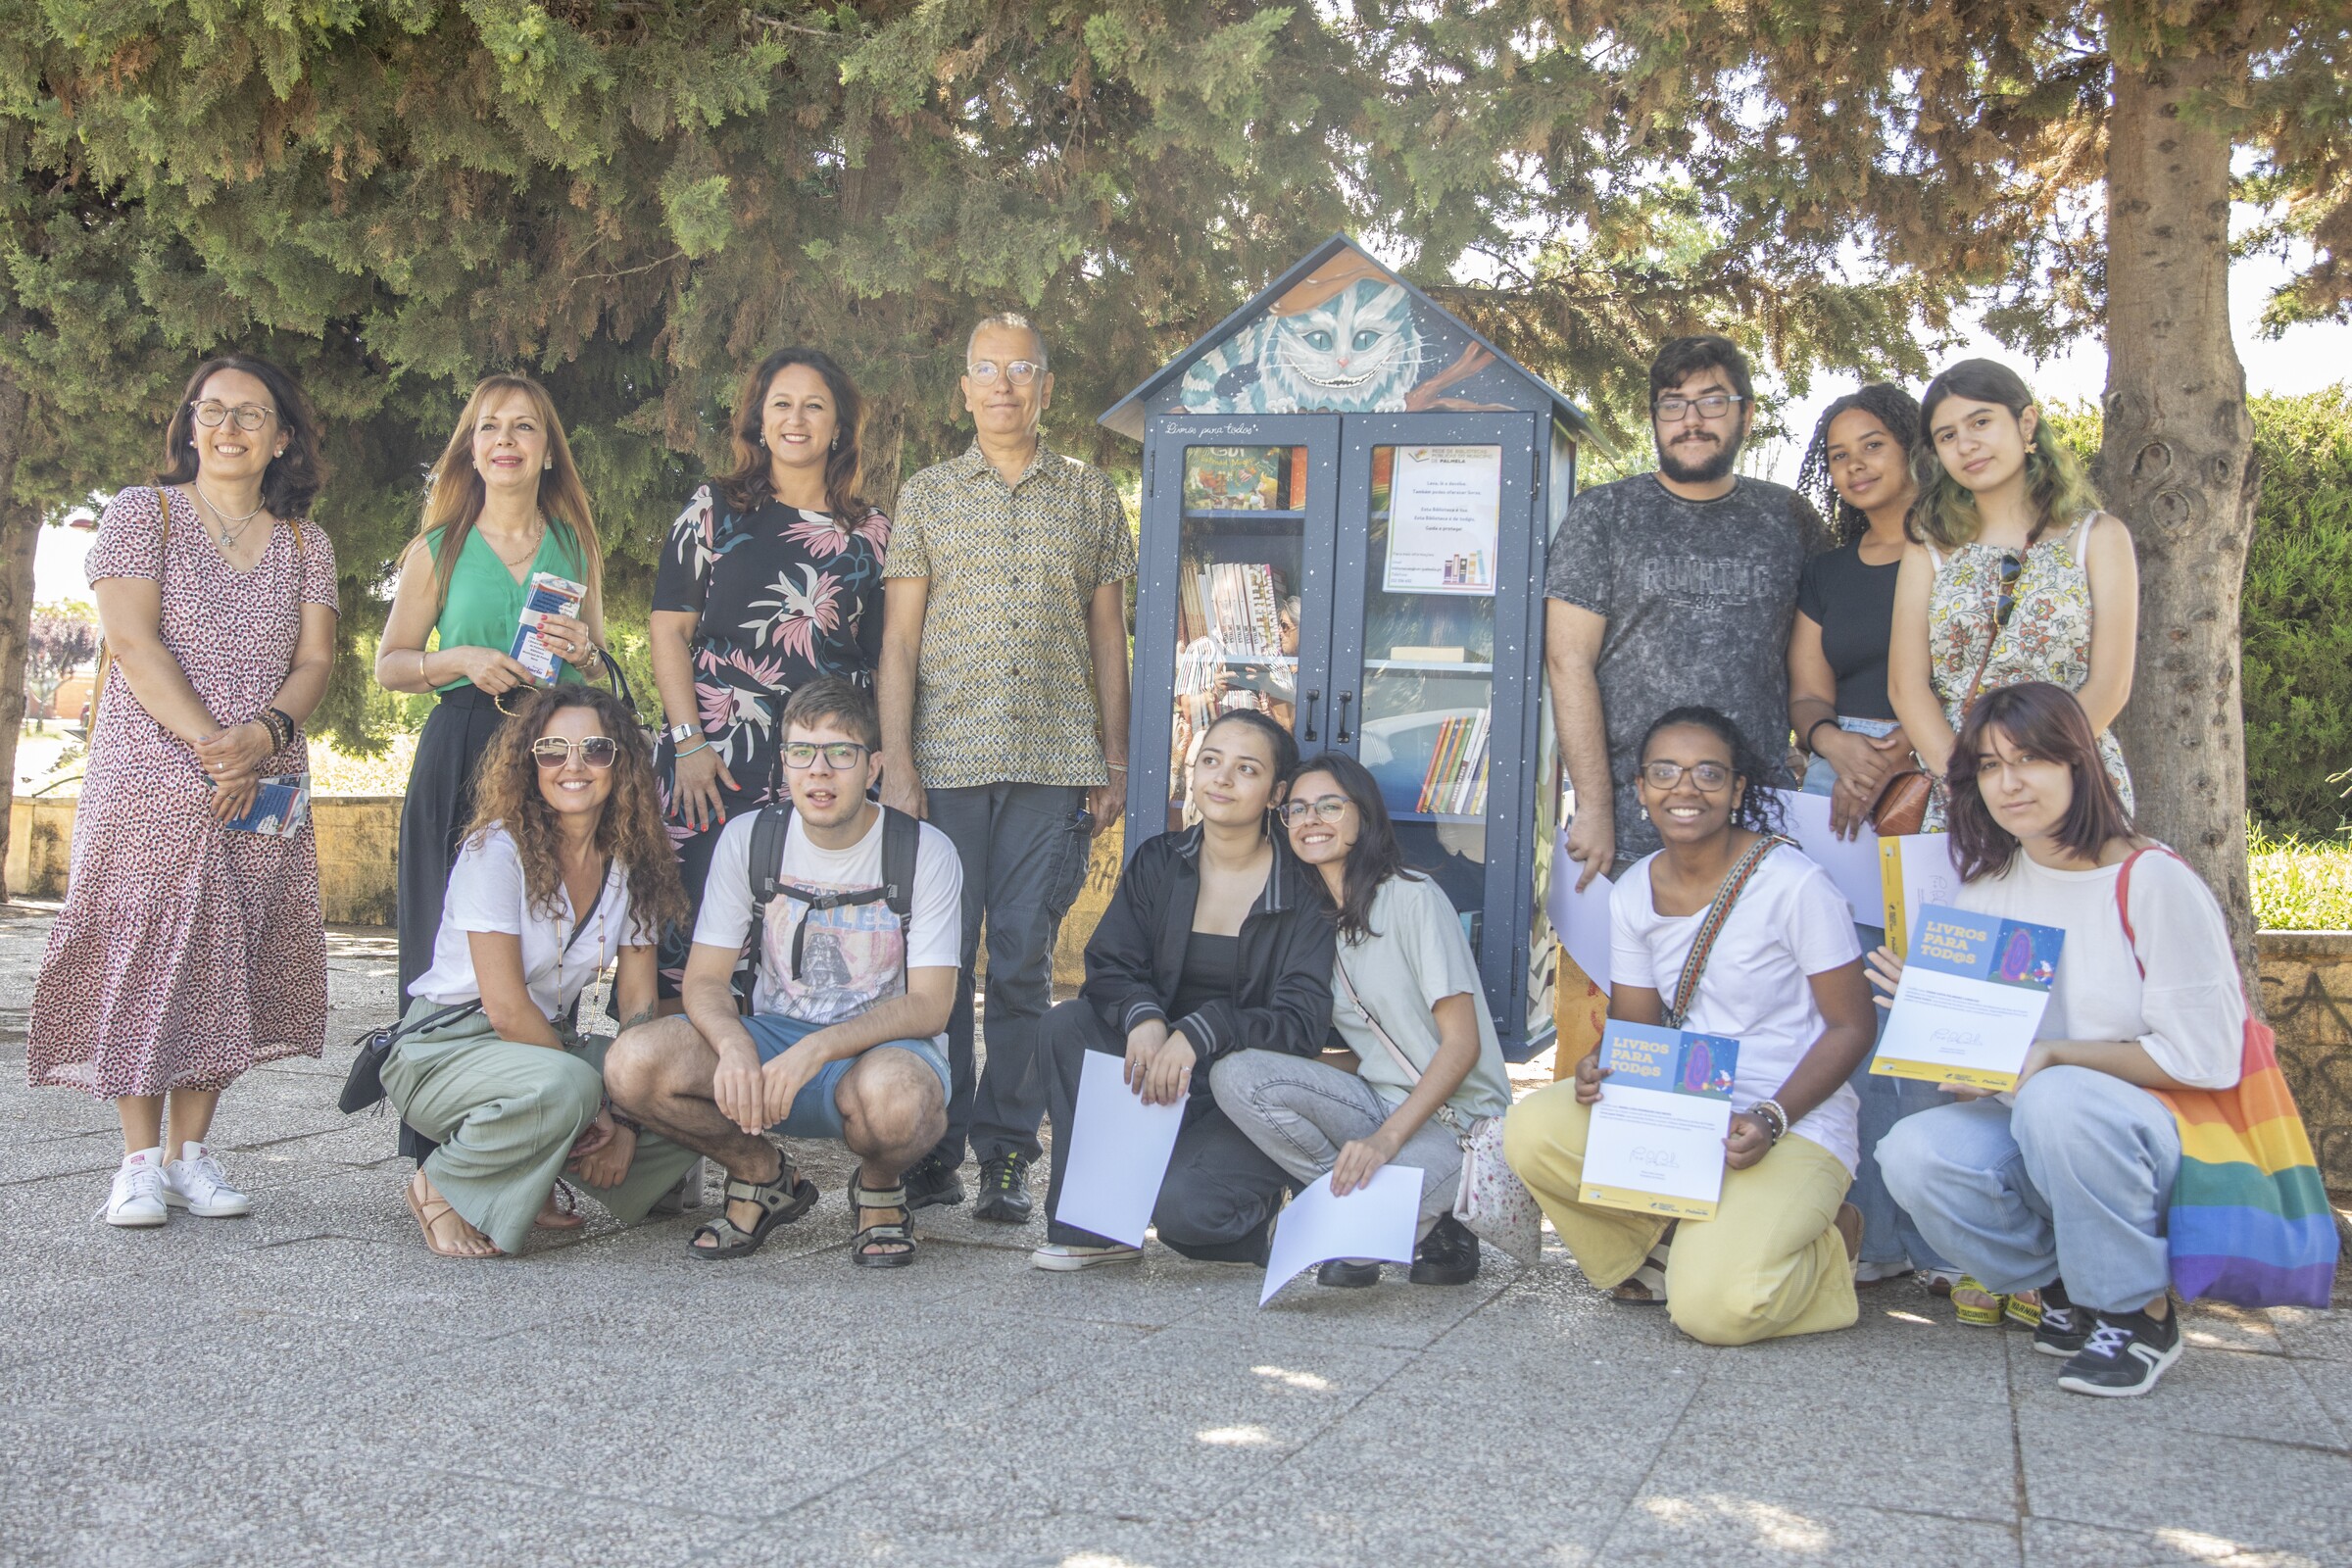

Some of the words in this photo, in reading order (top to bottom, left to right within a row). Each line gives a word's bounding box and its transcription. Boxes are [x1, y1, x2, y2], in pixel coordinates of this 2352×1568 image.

[1926, 920, 1987, 942] LIVROS
[1923, 932, 1969, 951] PARA
[1920, 944, 1976, 964] TOD@S
[1613, 1037, 1669, 1054] LIVROS
[1611, 1049, 1654, 1064] PARA
[1609, 1059, 1662, 1077] TOD@S
